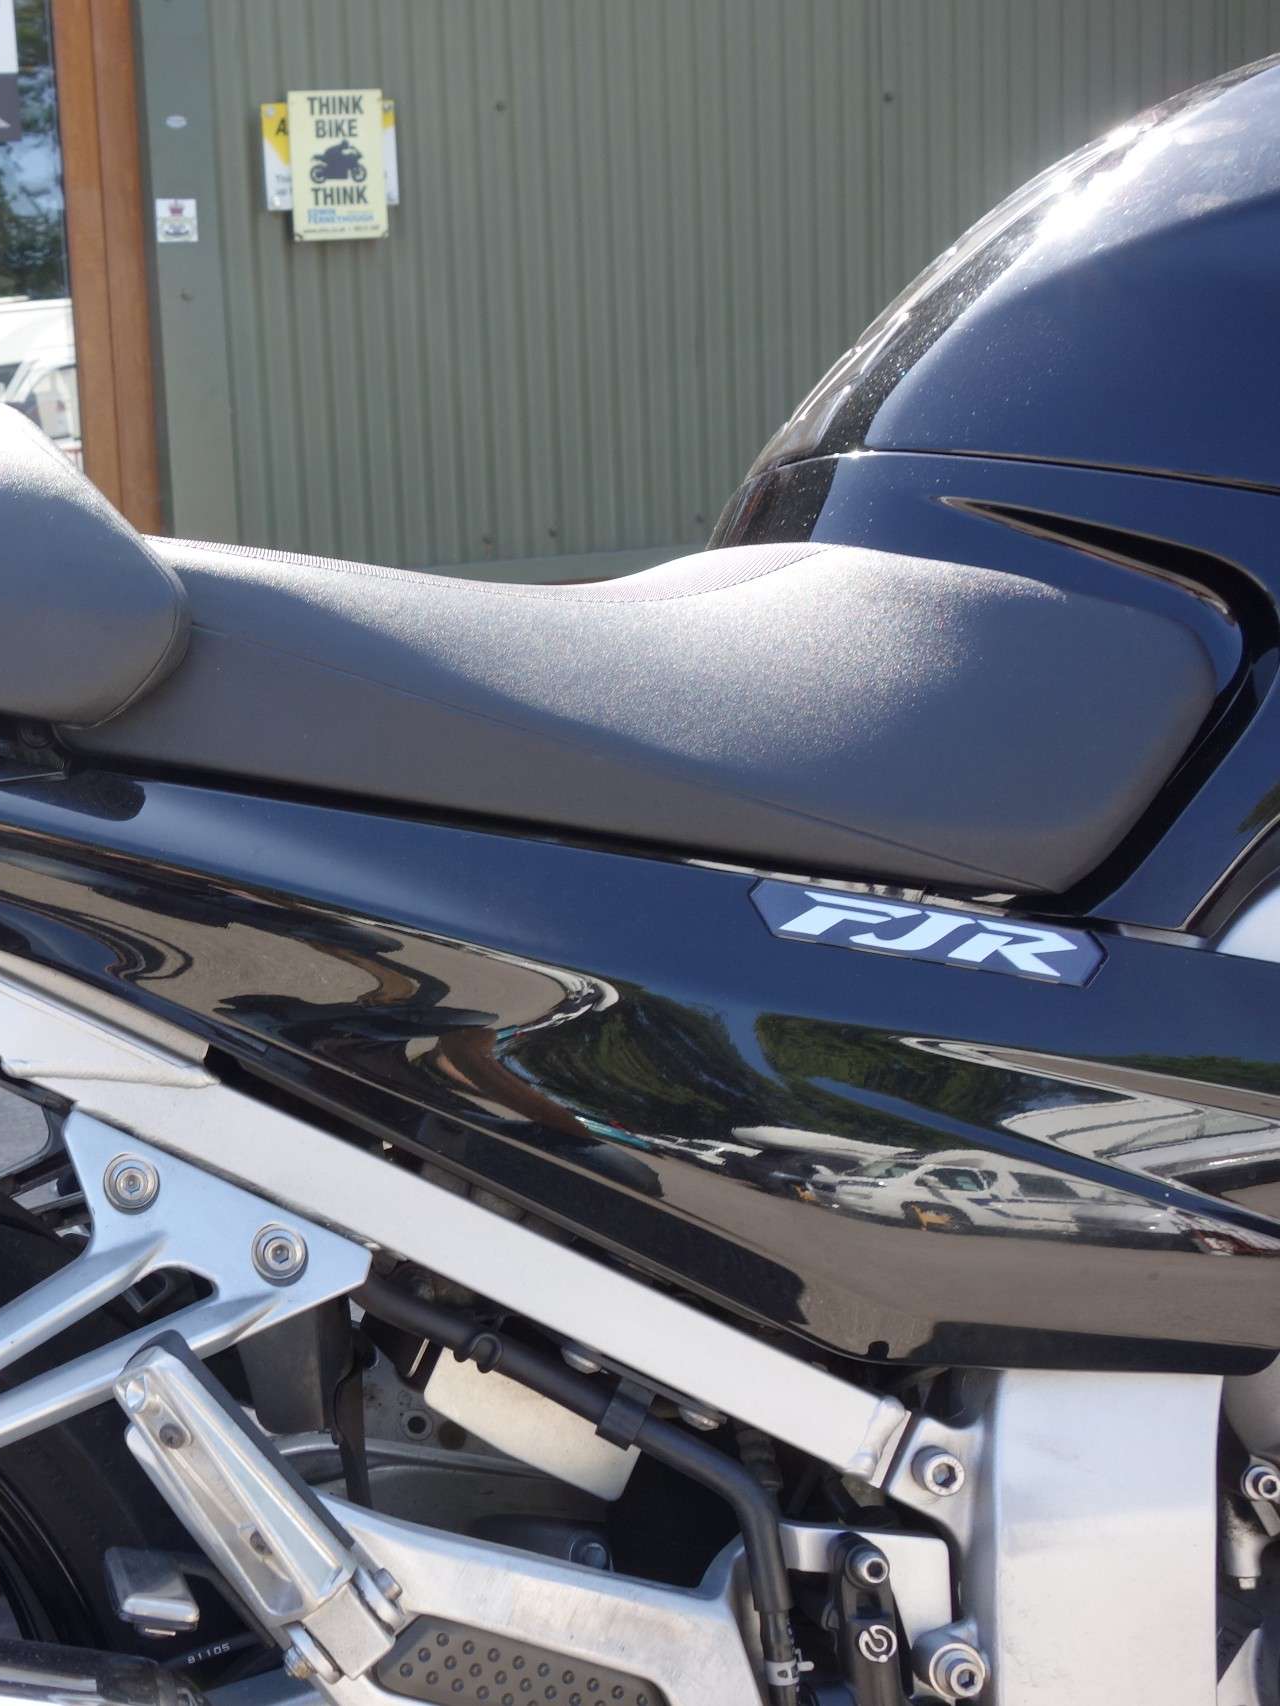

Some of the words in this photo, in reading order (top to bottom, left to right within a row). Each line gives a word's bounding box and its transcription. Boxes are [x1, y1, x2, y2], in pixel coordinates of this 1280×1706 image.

[306, 95, 365, 116] THINK
[314, 119, 359, 139] BIKE
[310, 185, 369, 206] THINK
[778, 890, 1078, 977] FJR
